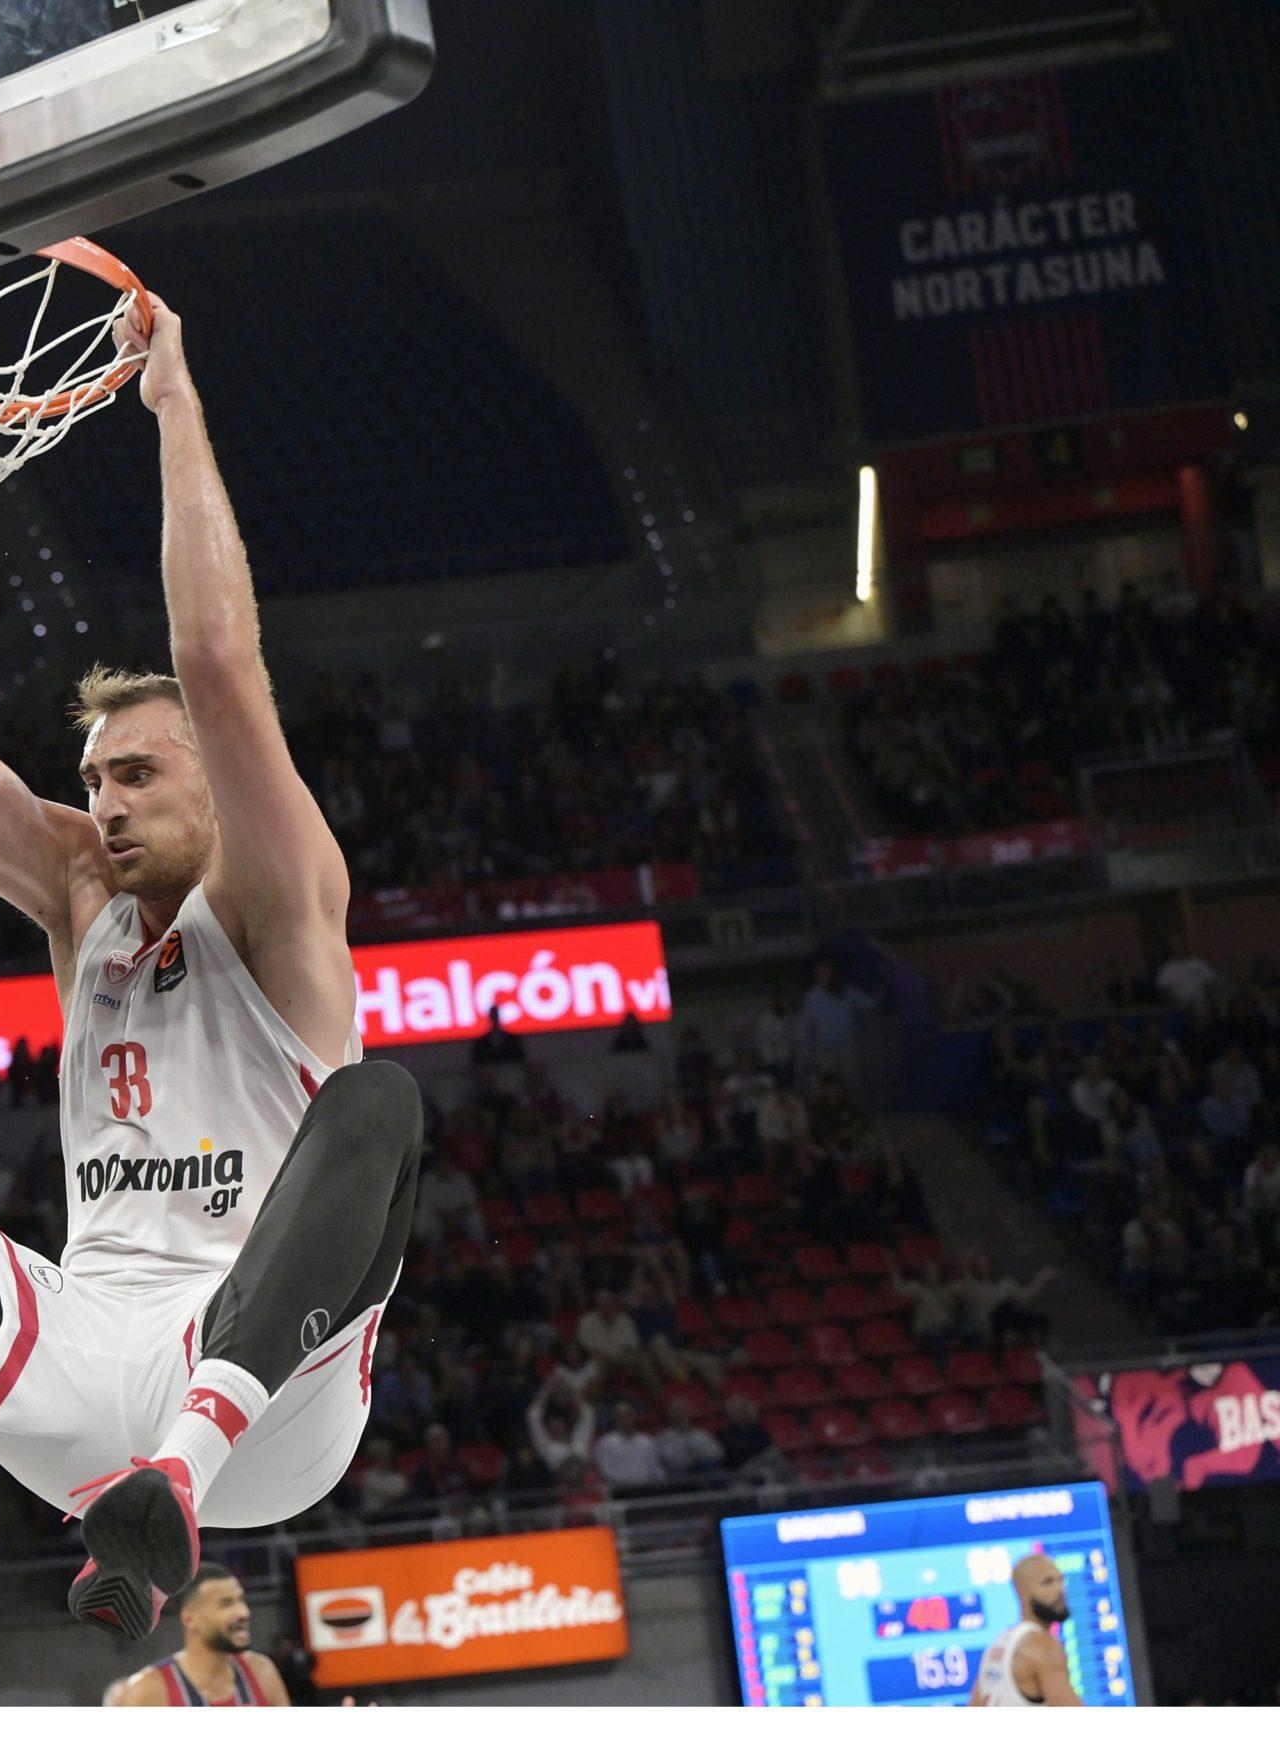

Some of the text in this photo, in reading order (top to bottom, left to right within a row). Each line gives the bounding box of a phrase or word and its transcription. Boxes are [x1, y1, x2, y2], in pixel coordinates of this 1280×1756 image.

[899, 191, 1139, 264] CARÁCTER
[891, 242, 1166, 322] NORTASUNA
[354, 949, 625, 1036] Halcón
[100, 1041, 153, 1120] 33
[202, 1186, 244, 1218] .gr
